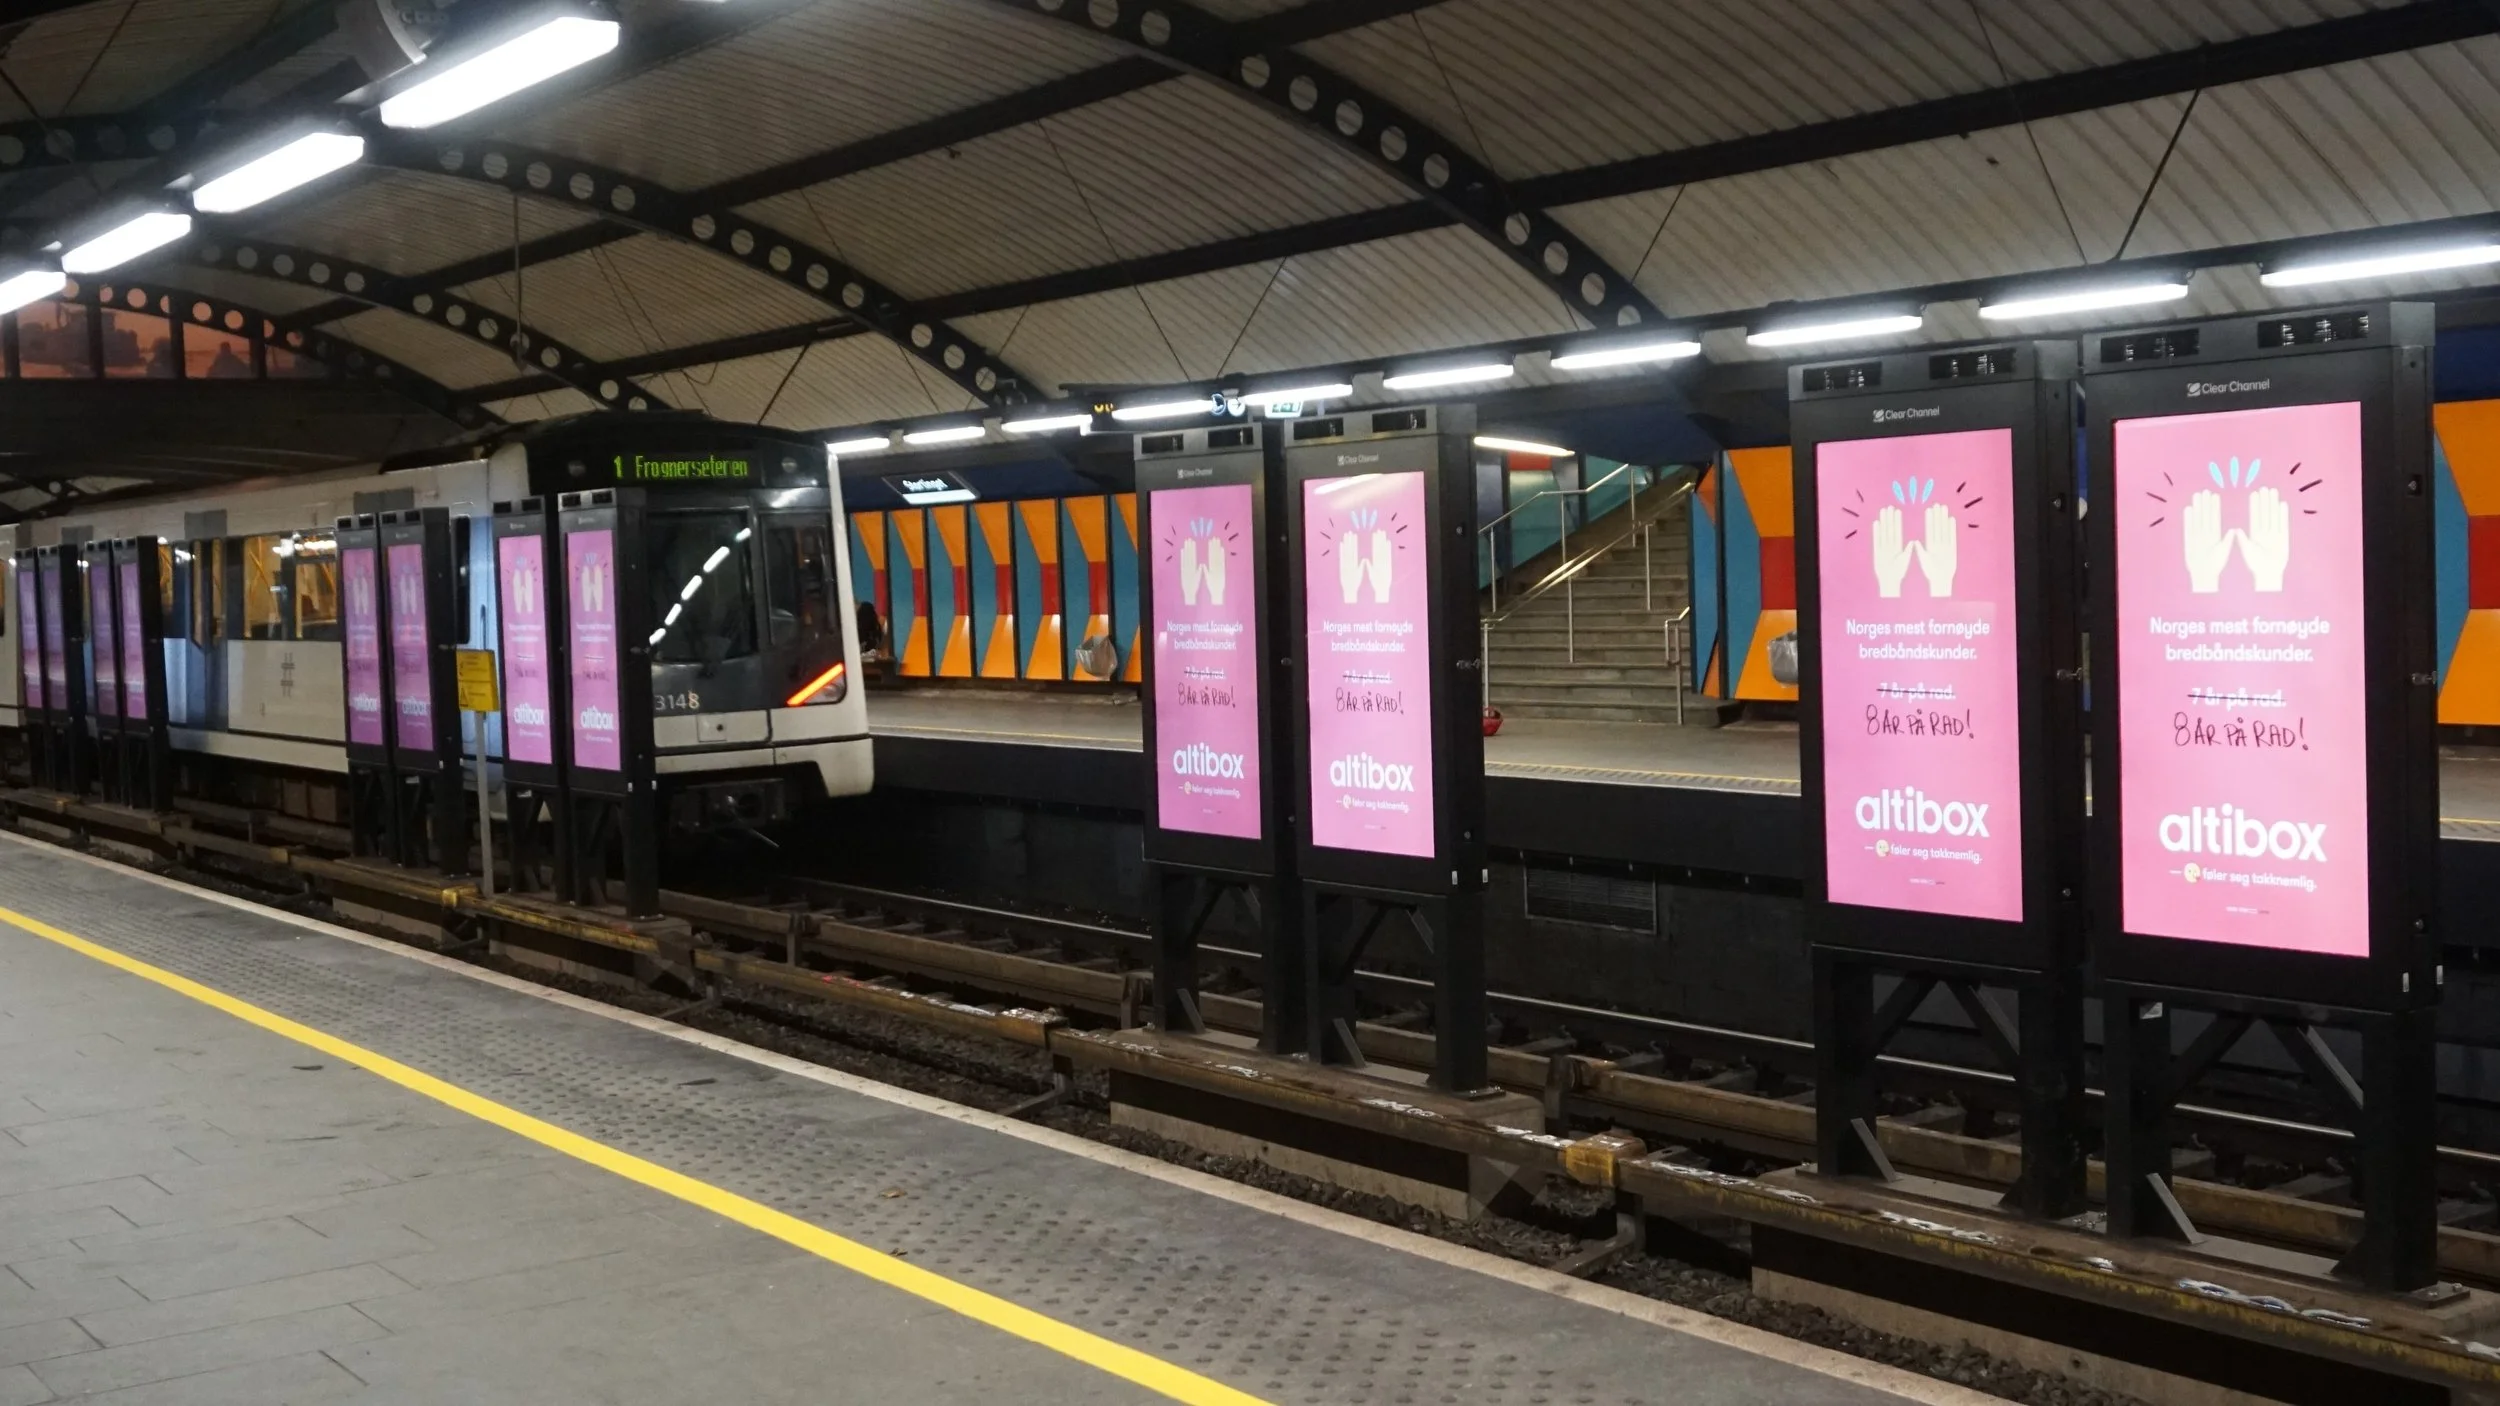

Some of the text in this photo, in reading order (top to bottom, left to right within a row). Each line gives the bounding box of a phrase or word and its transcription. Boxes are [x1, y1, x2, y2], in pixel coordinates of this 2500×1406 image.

[2202, 378, 2270, 394] Clear Channel
[1885, 405, 1940, 420] Clear Channel
[613, 454, 748, 478] 1 Frognerseteren
[1846, 618, 1990, 639] Norges mest fornøyde
[2150, 616, 2330, 639] Norges mest fornøyde
[1858, 641, 1977, 660] bredbåndskunder.
[2165, 642, 2314, 662] bredbåndskunder.
[654, 691, 700, 711] 3148
[1177, 681, 1186, 706] 8
[1200, 685, 1210, 706] PÅ
[1211, 685, 1236, 708] RAD!
[1335, 686, 1346, 712] 8
[1361, 690, 1373, 712] PÅ
[1375, 691, 1404, 715] RAD!
[1880, 682, 1888, 698] 7
[2192, 687, 2201, 705] 7
[1866, 703, 1880, 735] 8
[1906, 708, 1925, 736] PÅ
[1929, 708, 1975, 739] RAD!
[2174, 711, 2191, 746] 8
[2223, 717, 2247, 747] PÅ
[2253, 717, 2309, 750] RAD!
[1172, 742, 1245, 780] altibox
[1329, 751, 1415, 793] altibox
[1855, 785, 1990, 838] altibox
[2159, 802, 2328, 863] altibox
[1912, 847, 1929, 860] seg
[2230, 871, 2250, 887] seg
